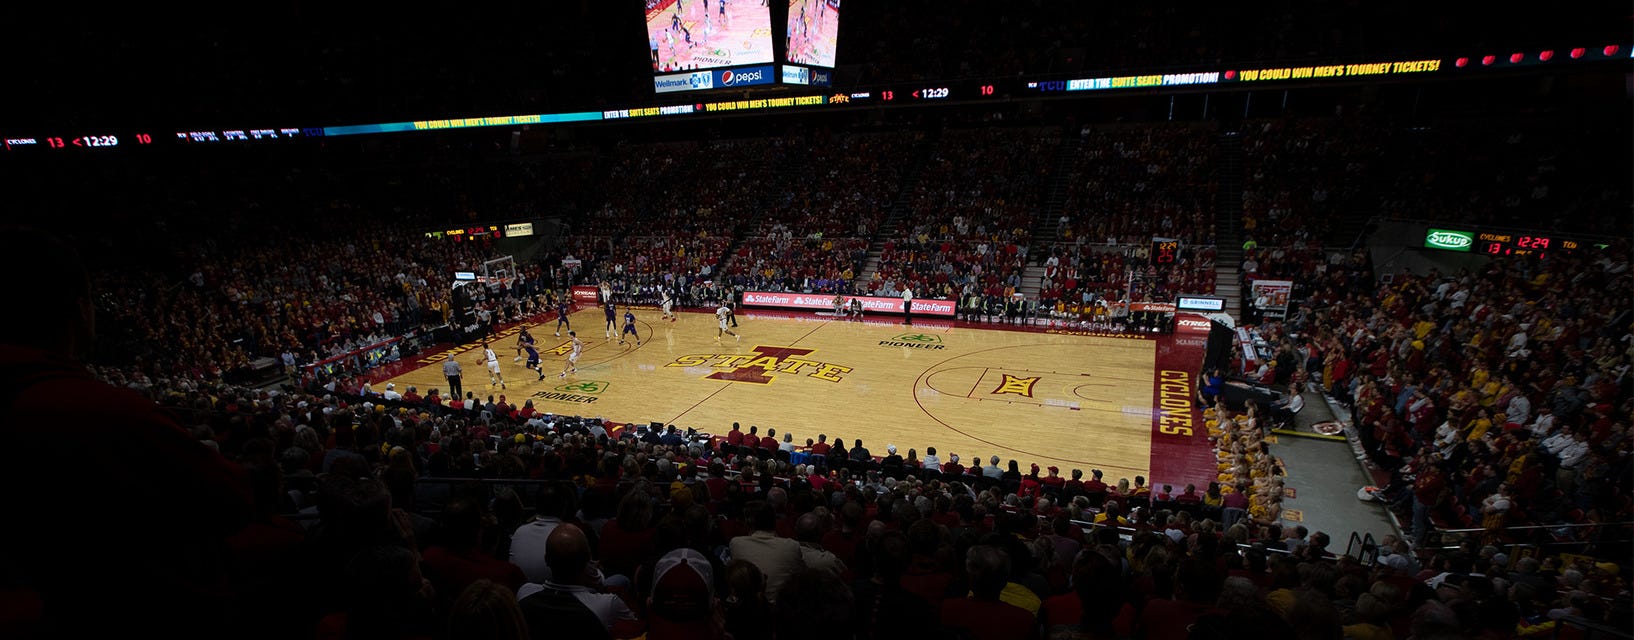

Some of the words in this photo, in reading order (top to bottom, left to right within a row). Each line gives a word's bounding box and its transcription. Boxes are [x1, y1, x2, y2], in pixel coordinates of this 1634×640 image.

[735, 69, 763, 83] pepsi
[1240, 70, 1259, 82] YOU
[1259, 68, 1291, 81] COULD
[1292, 67, 1313, 79] WIN
[1313, 65, 1345, 78] MEN'S
[1346, 62, 1392, 76] TOURNEY
[1392, 59, 1441, 74] TICKETS!
[655, 79, 688, 88] Wellmark
[1070, 79, 1095, 90] ENTER
[1095, 77, 1112, 89] THE
[1111, 76, 1137, 88] SUITE
[1136, 74, 1163, 86] SEATS
[1162, 72, 1220, 86] PROMOTION!
[882, 91, 894, 100] 13
[922, 88, 950, 98] 12:29
[981, 85, 994, 95] 10
[705, 103, 718, 112] YOU
[718, 101, 737, 111] COULD
[736, 100, 750, 110] WIN
[749, 99, 768, 109] MEN'S
[767, 97, 796, 108] TOURNEY
[795, 95, 824, 106] TICKETS!
[604, 110, 620, 120] ENTER
[629, 108, 644, 117] SUITE
[643, 107, 660, 116] SEATS
[47, 137, 65, 148] 13
[83, 135, 118, 147] 12:29
[136, 133, 152, 144] 10
[1431, 231, 1469, 246] Sukup
[1517, 236, 1550, 249] 12:29
[1488, 242, 1501, 254] 13
[1157, 250, 1174, 264] 25
[1178, 319, 1212, 327] XTREA
[878, 341, 945, 350] PIONEER
[664, 353, 853, 383] STATE
[531, 391, 598, 404] PIONEER
[1160, 369, 1193, 436] CYCLONES
